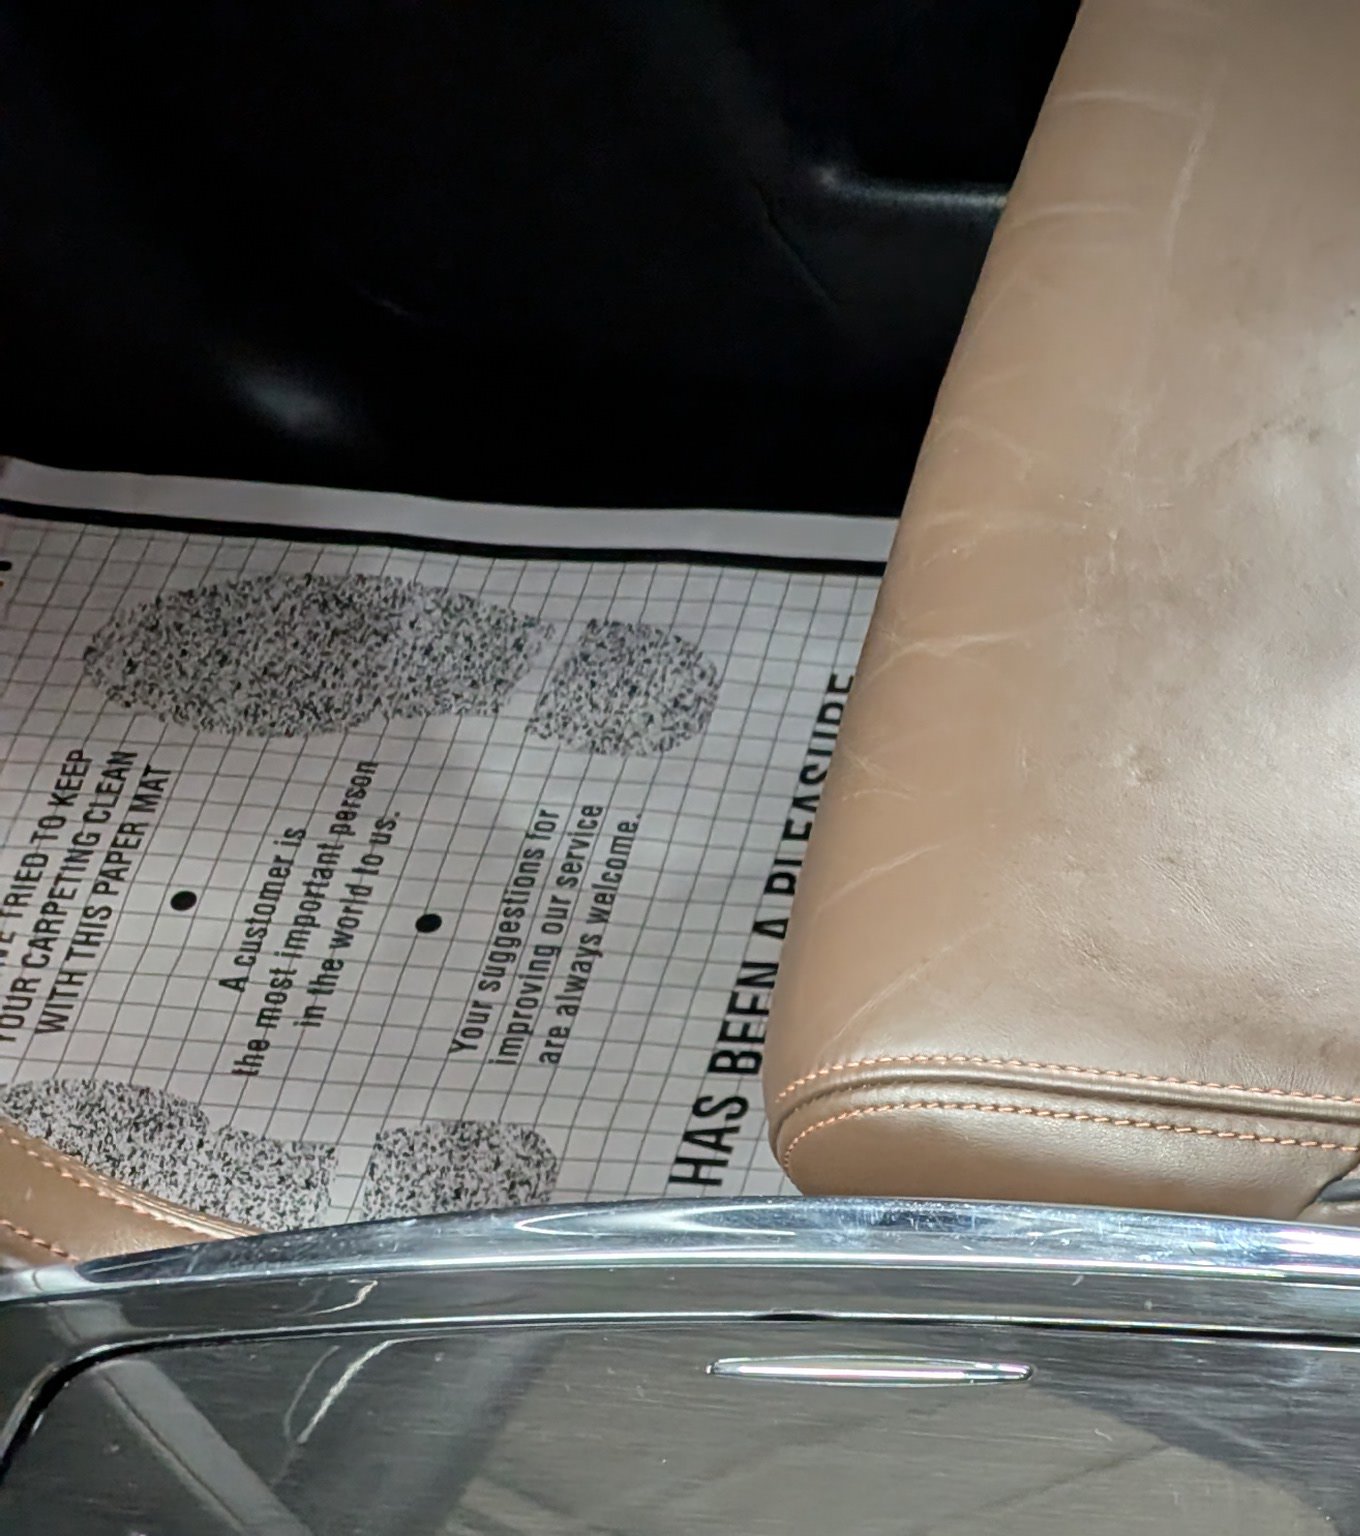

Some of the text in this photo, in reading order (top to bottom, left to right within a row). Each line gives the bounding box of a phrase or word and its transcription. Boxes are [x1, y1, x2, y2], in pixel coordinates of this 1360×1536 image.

[0, 853, 49, 918] TRIED
[21, 831, 102, 969] CARPETING
[83, 751, 138, 823] CLEAN
[31, 815, 67, 844] TO
[48, 749, 93, 807] KEEP
[35, 764, 172, 1034] WITH THIS PAPER MAT
[218, 827, 307, 993] A customer is
[231, 759, 379, 1077] the most important person
[293, 811, 402, 1028] in the world to us.
[448, 808, 560, 1054] Your suggestions for
[487, 804, 604, 1066] improving our service
[539, 813, 643, 1065] are always welcome.
[706, 961, 780, 1076] BEEN
[667, 1095, 750, 1187] HAS
